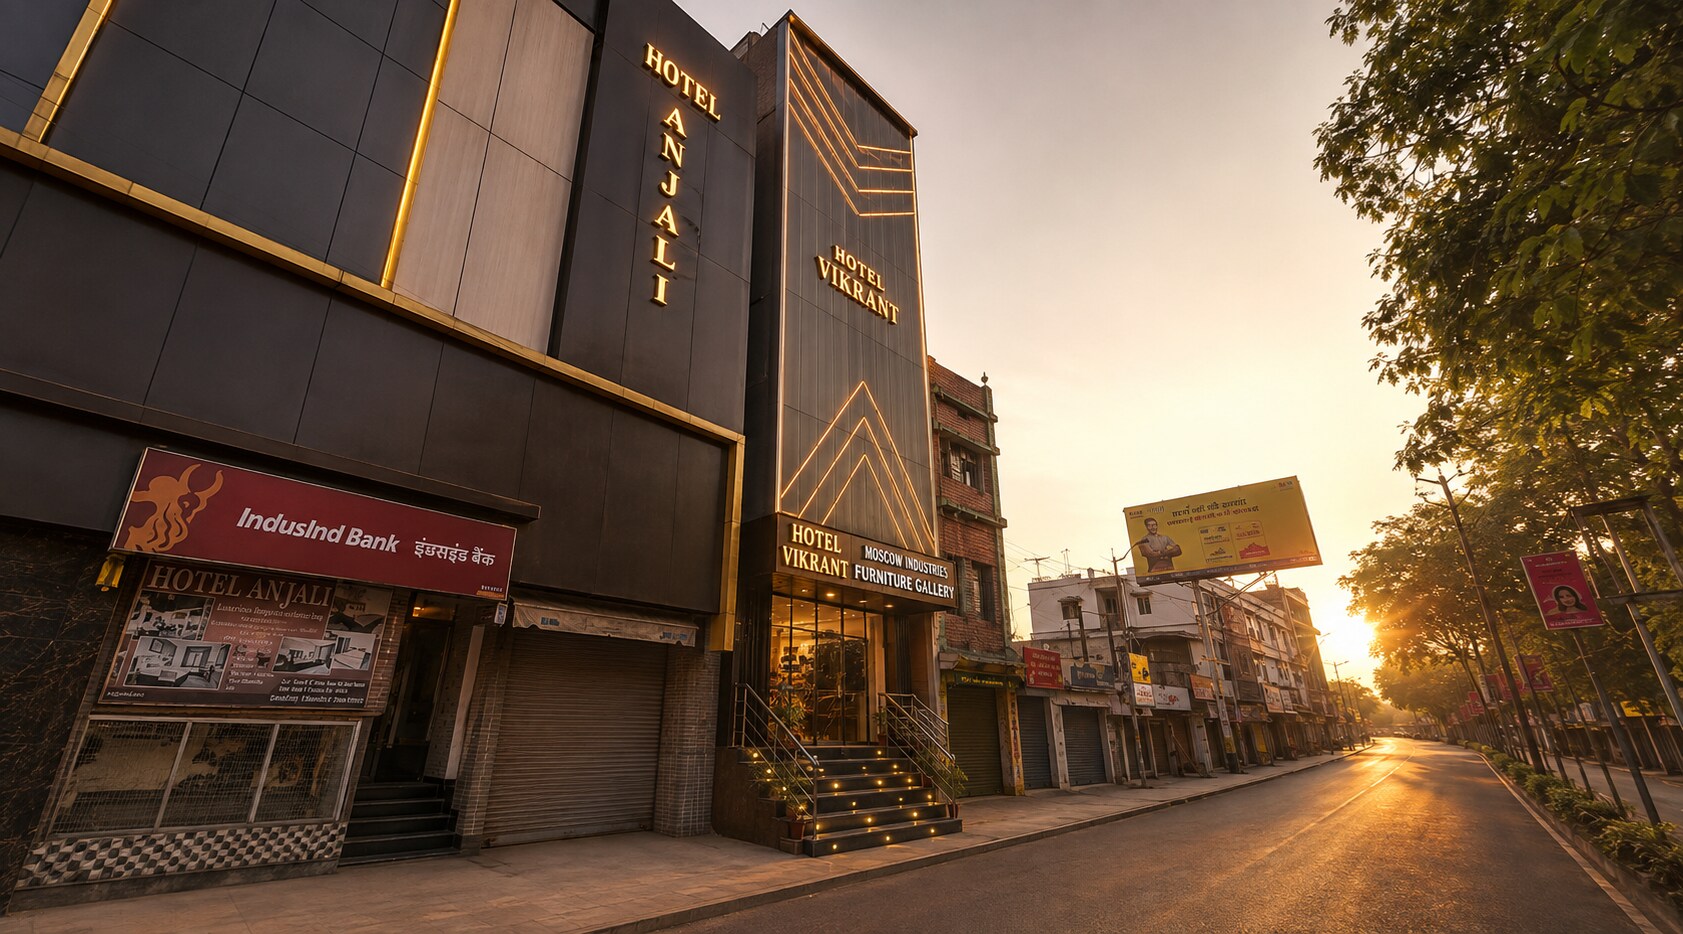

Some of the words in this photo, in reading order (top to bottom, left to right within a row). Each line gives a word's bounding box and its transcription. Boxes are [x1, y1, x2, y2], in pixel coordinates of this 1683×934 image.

[644, 42, 721, 121] HOTEL
[651, 107, 688, 306] ANJALI
[815, 255, 899, 325] VIKRANT
[833, 245, 885, 292] HOTEL
[236, 507, 346, 544] IndusInd
[345, 527, 400, 553] Bank
[791, 523, 841, 554] HOTEL
[471, 546, 496, 566] बैंक
[782, 545, 849, 579] VIKRANT
[864, 545, 903, 567] MOSCOW
[905, 556, 949, 579] INDUSTRIES
[147, 565, 241, 597] HOTEL
[246, 577, 333, 608] ANJALI
[854, 564, 913, 591] FURNITURE
[915, 578, 955, 599] GALLERY
